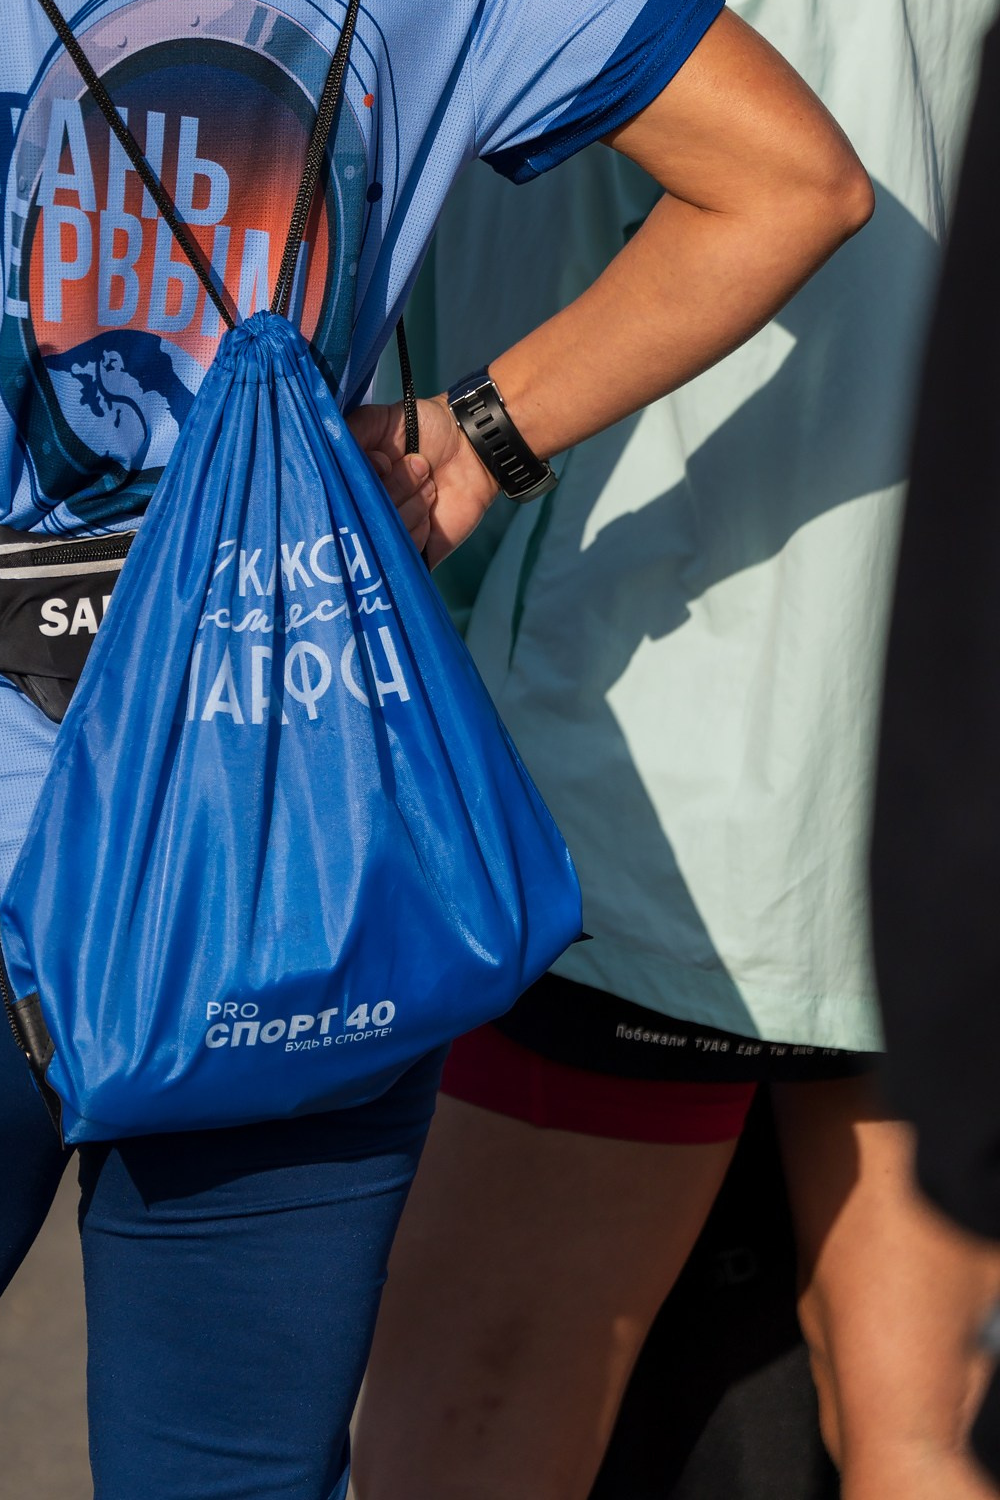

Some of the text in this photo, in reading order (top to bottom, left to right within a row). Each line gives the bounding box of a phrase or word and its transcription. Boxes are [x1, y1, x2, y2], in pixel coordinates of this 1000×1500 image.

[206, 1001, 259, 1020] PRO
[205, 1000, 396, 1049] СПОРТ 40
[285, 1040, 320, 1052] БУДЬ
[323, 1036, 332, 1047] В
[616, 1023, 687, 1048] Побежали
[695, 1037, 730, 1053] туда
